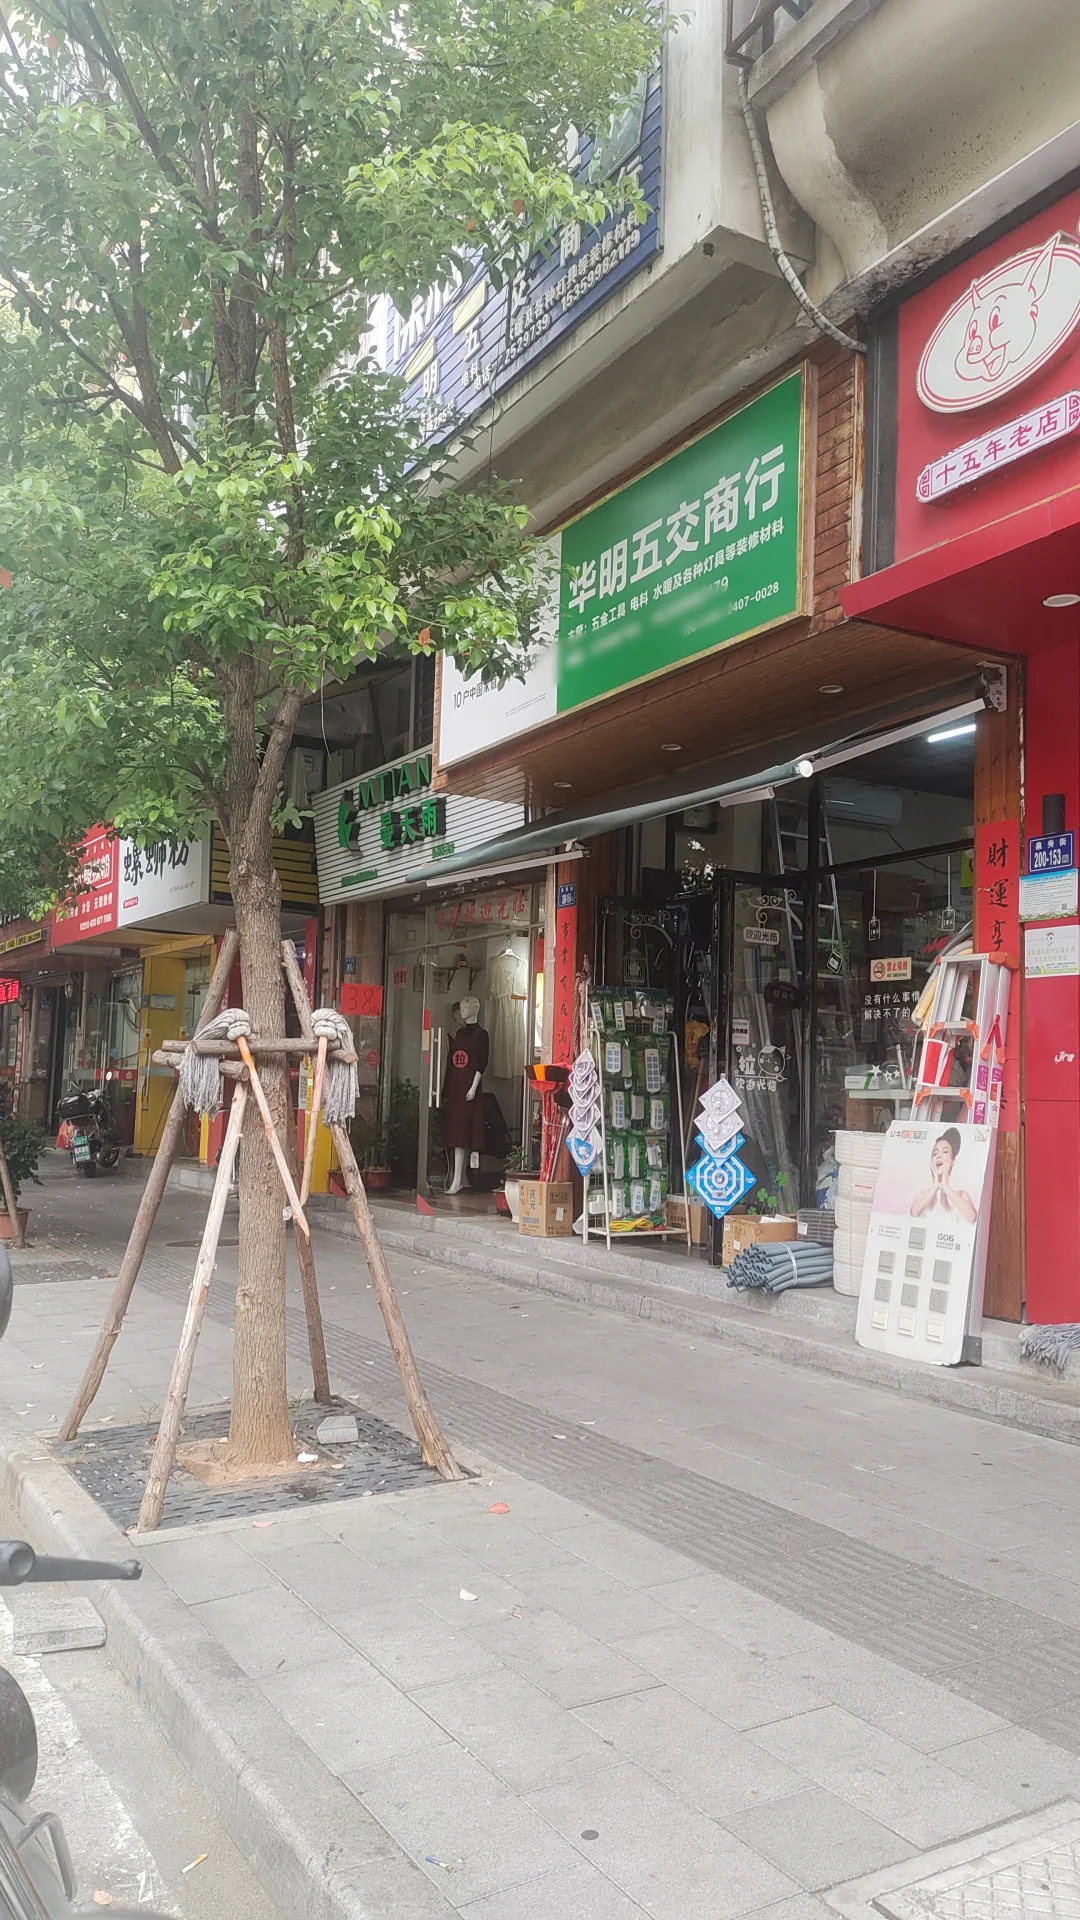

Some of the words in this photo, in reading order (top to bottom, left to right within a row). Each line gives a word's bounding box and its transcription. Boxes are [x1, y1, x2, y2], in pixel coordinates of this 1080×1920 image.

[560, 229, 641, 312] 15359982179
[936, 408, 1060, 485] 十五年老店
[568, 444, 785, 614] 华明五交商行
[592, 604, 627, 632] 五金工具
[630, 594, 648, 612] 电料
[653, 516, 784, 600] 水暖及各种灯具等装修材料
[379, 797, 440, 852] 曼天雨
[1035, 837, 1067, 851] 泉秀街
[1034, 848, 1062, 869] 200-153
[744, 928, 779, 943] 欢迎光临
[348, 986, 374, 1014] 38
[864, 990, 921, 1005] 没有什么事情
[864, 1006, 911, 1020] 解决不了的
[735, 1078, 777, 1091] 欢迎光临
